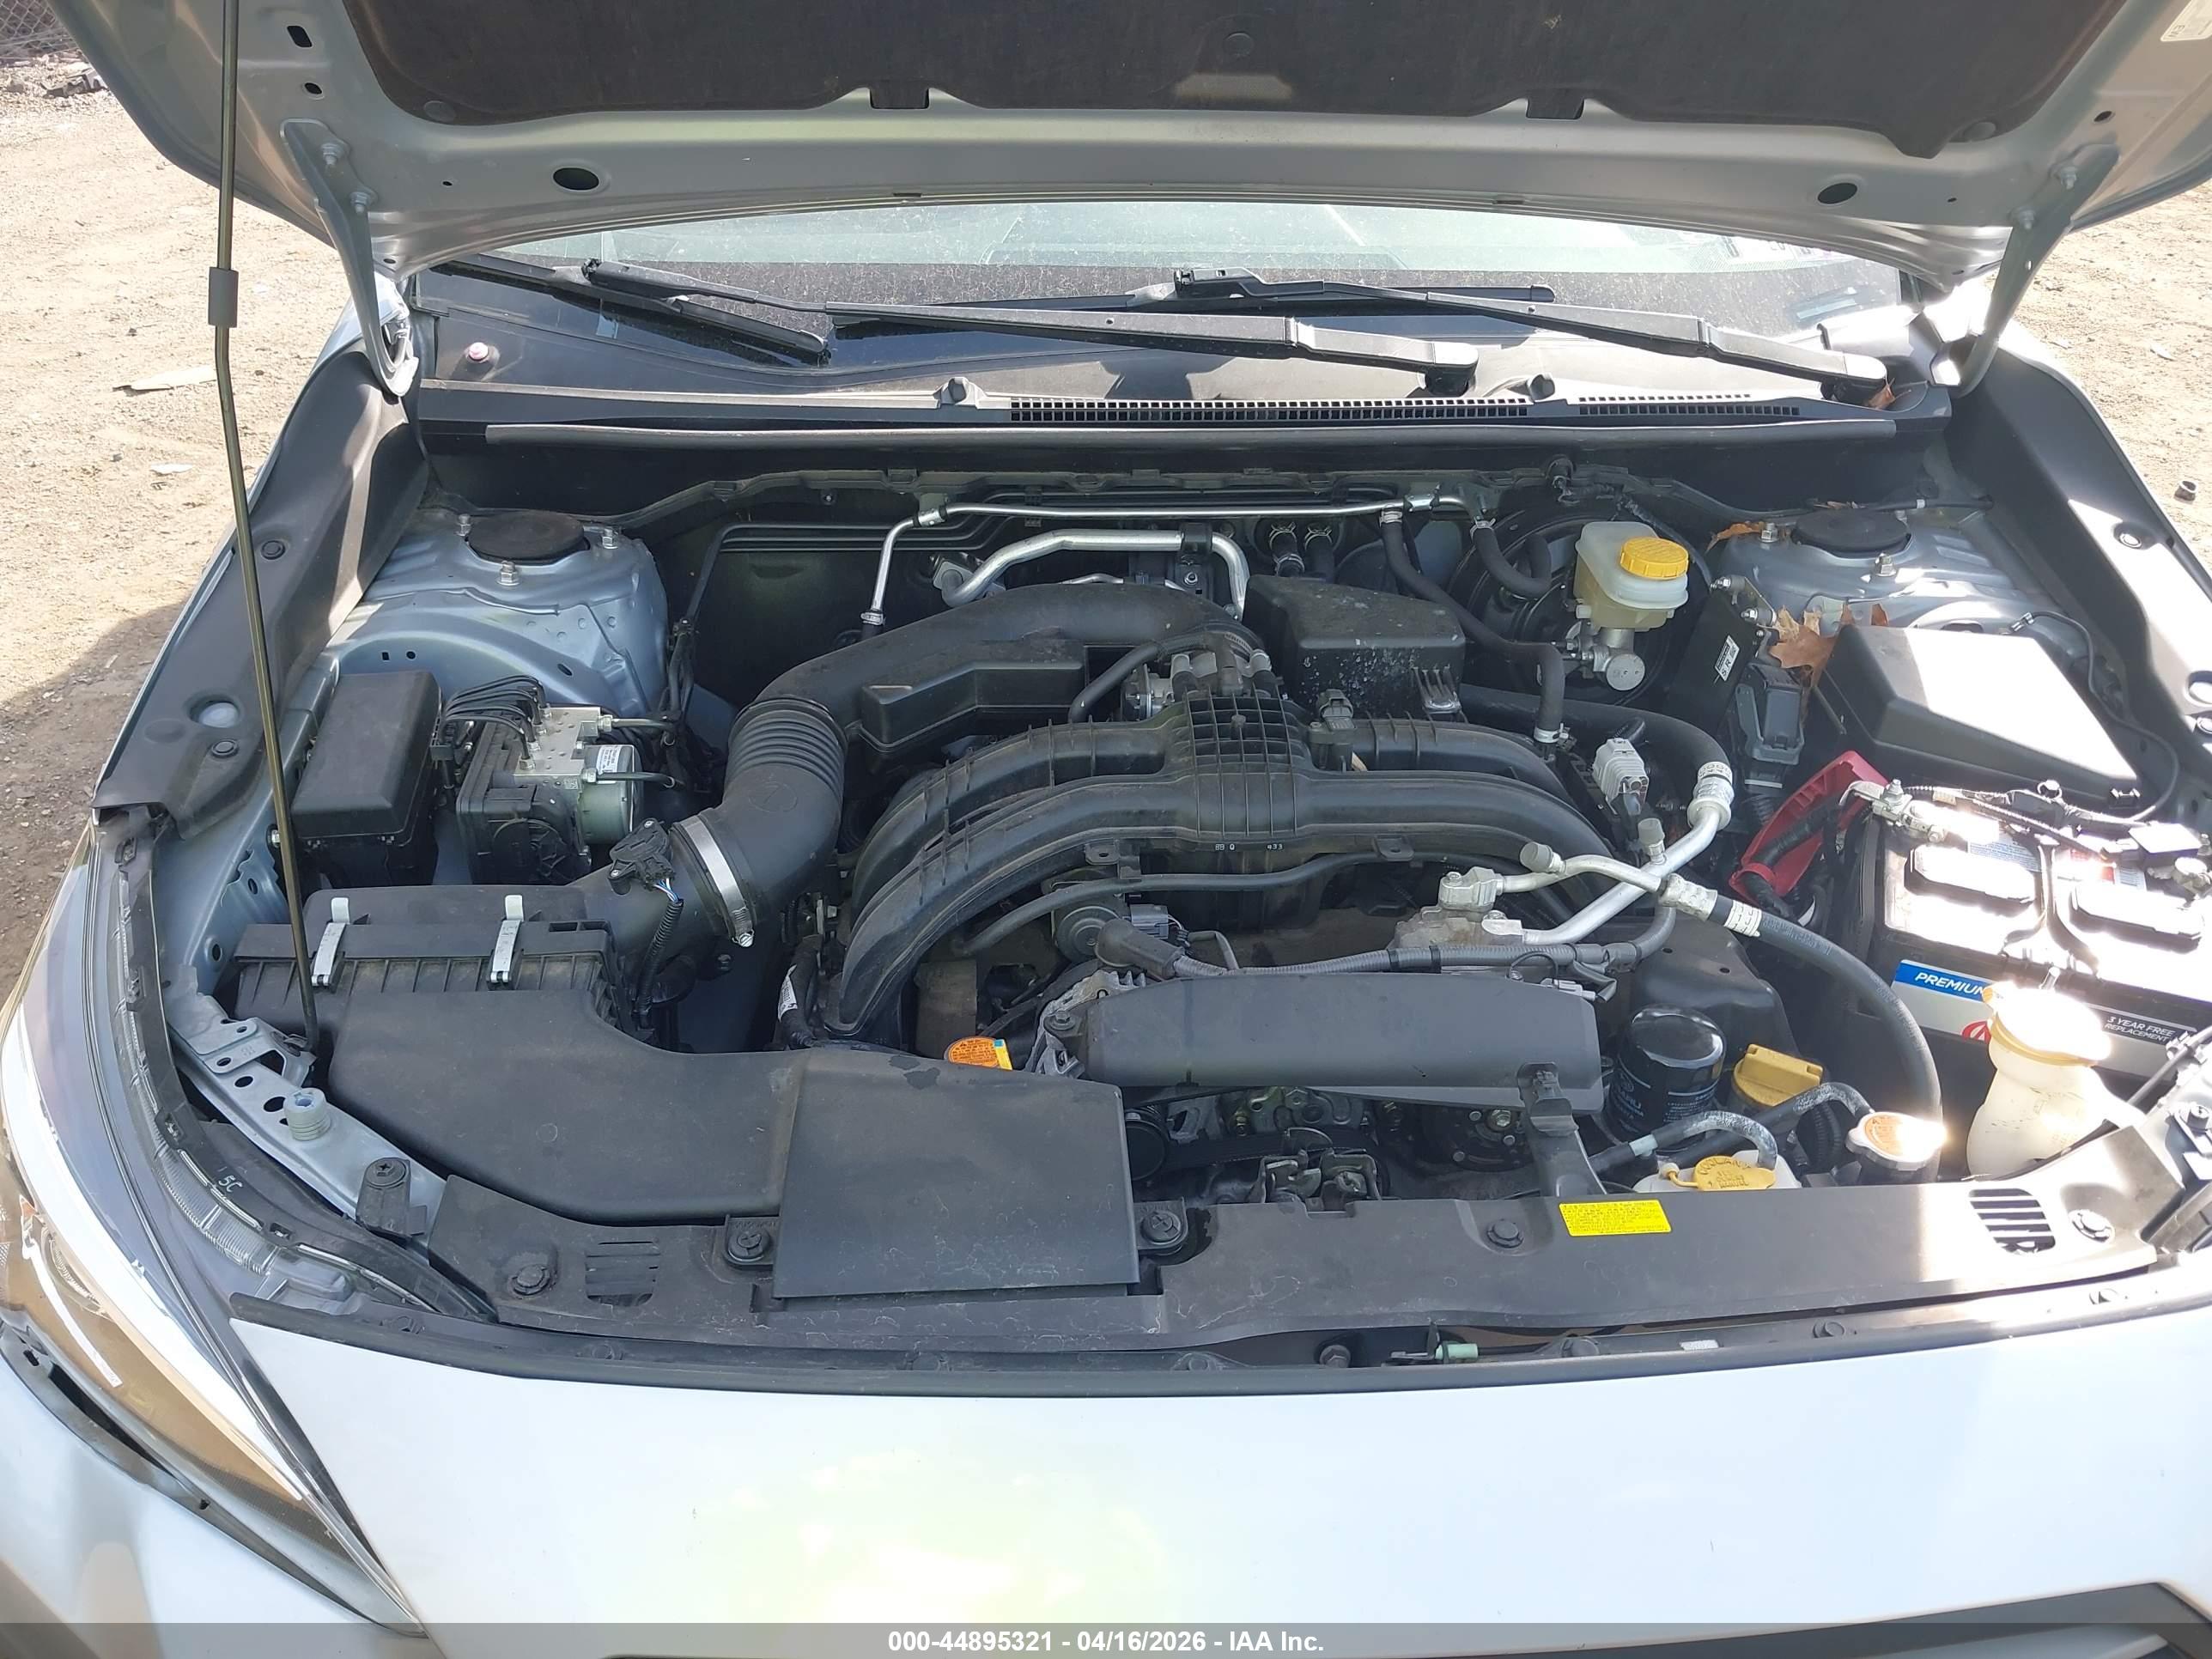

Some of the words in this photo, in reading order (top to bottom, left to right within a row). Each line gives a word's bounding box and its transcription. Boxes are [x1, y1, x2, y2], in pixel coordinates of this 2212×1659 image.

[2105, 1023, 2171, 1042] REPLACEMENT
[2118, 1018, 2146, 1031] YEAR
[2146, 1024, 2177, 1037] FREE
[218, 1175, 243, 1193] 5C
